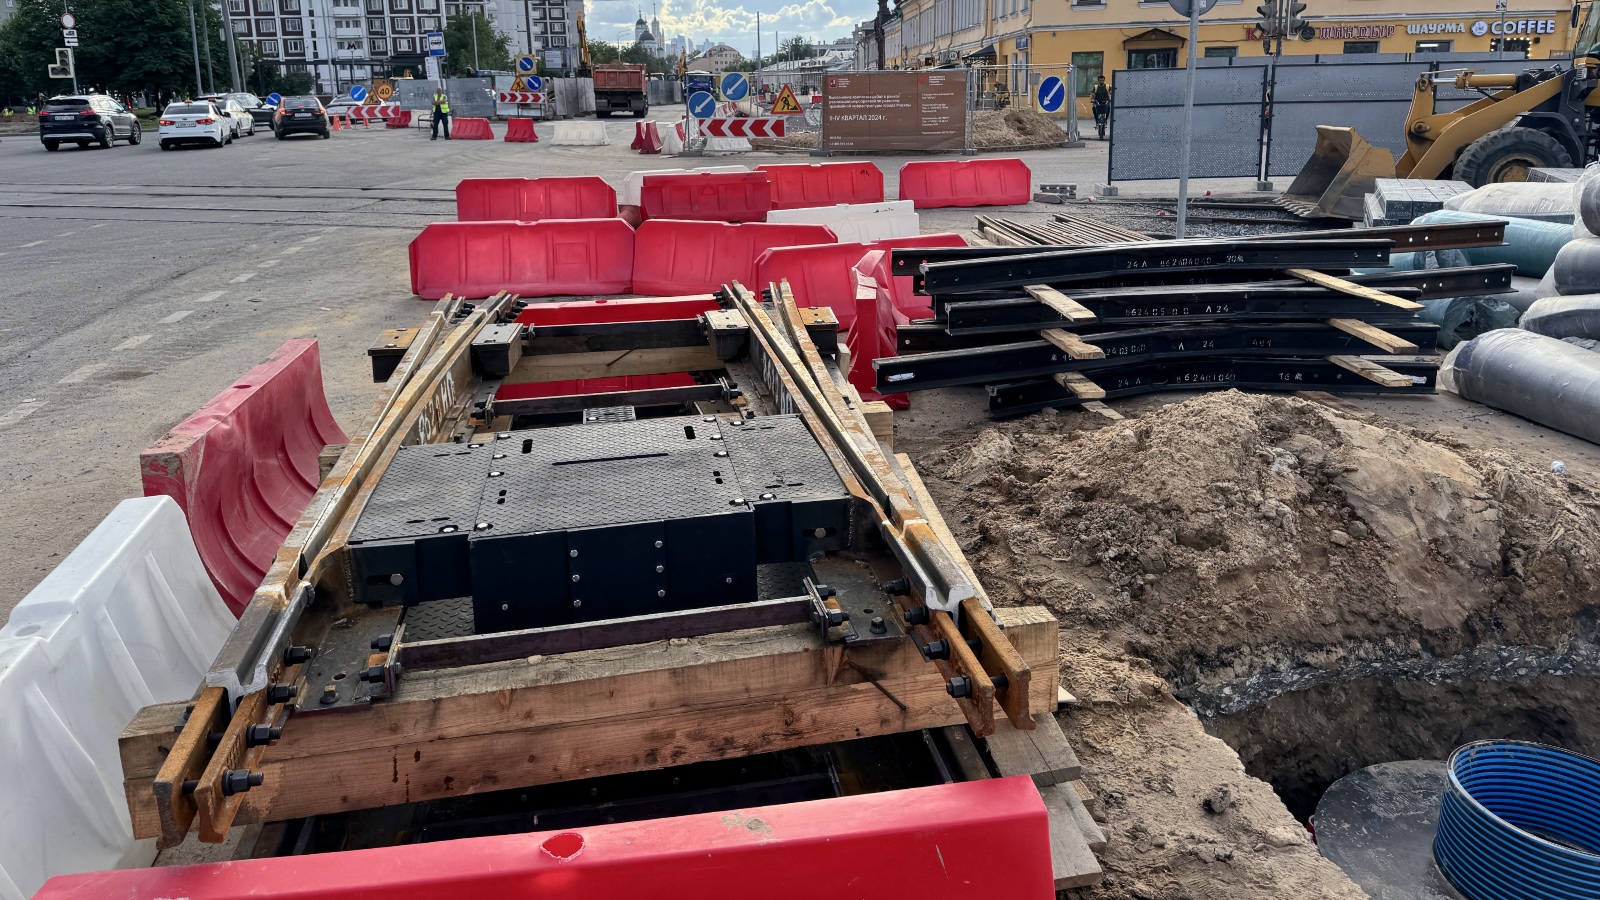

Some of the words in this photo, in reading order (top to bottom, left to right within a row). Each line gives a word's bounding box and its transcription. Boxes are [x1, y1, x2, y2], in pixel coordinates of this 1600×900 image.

[1407, 22, 1465, 34] ШАУРМА
[1491, 20, 1555, 35] COFFEE
[1126, 261, 1138, 269] 24
[1216, 304, 1229, 313] 24
[1202, 340, 1214, 348] 24
[1118, 379, 1129, 388] 24
